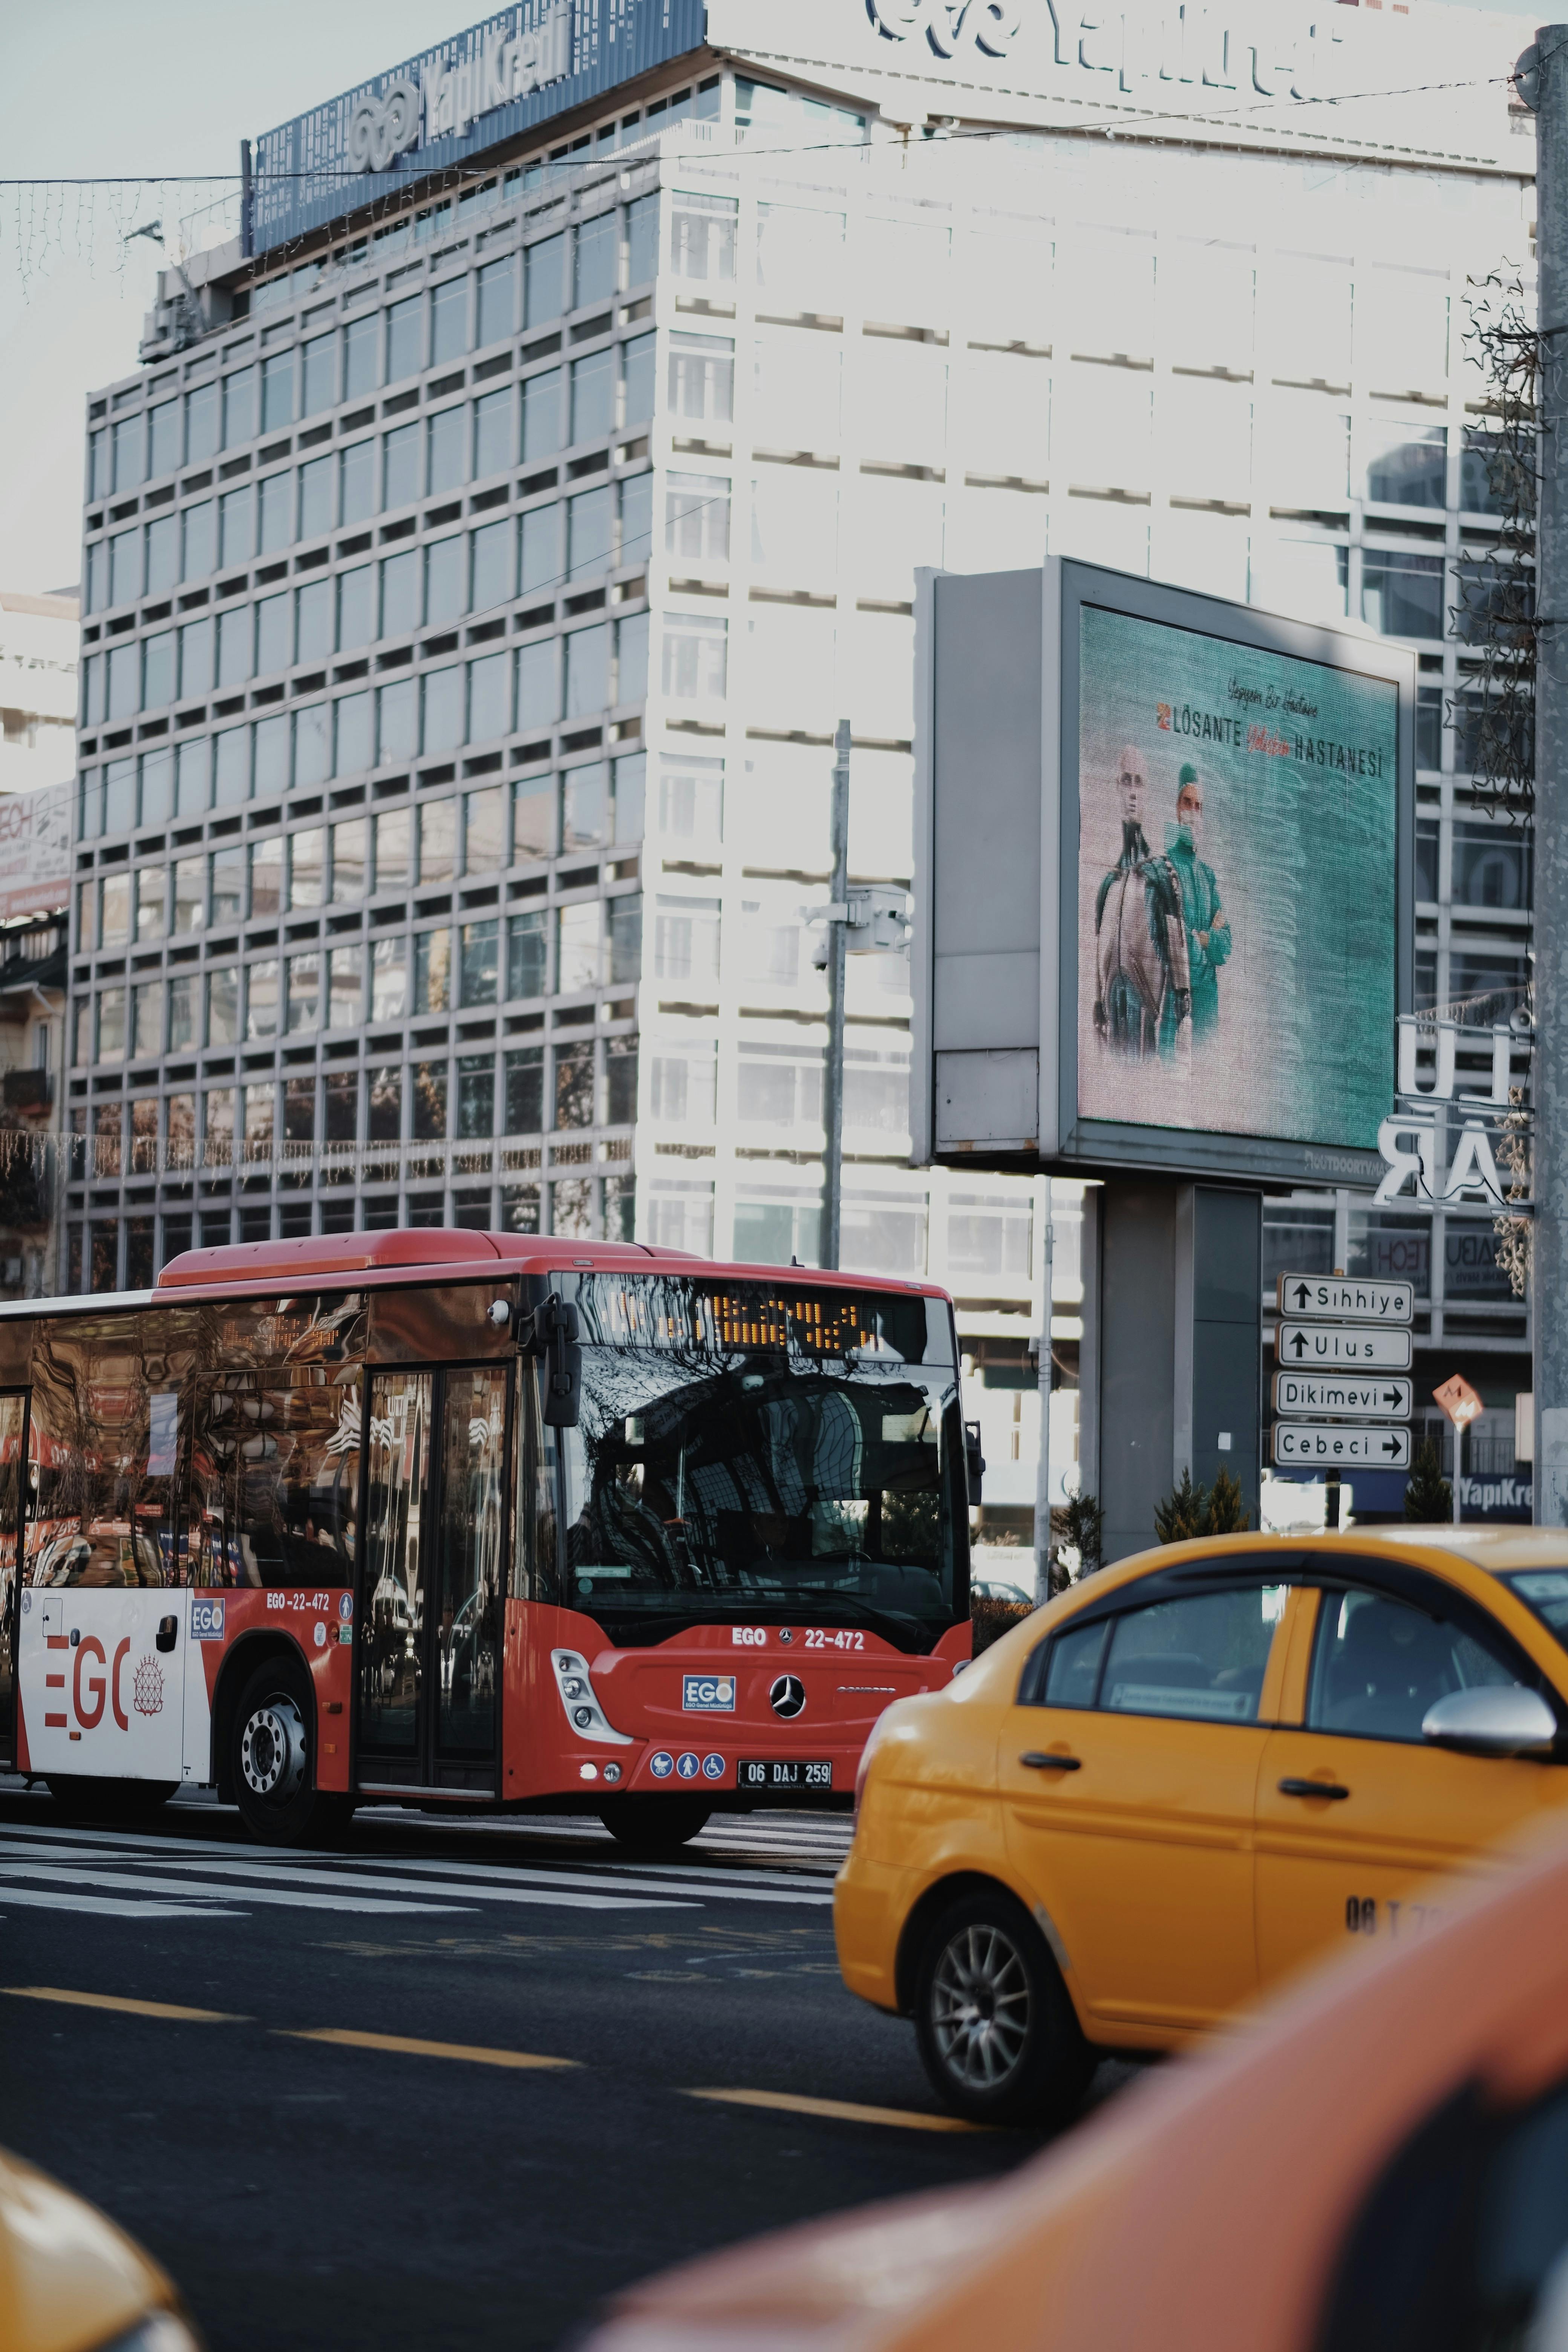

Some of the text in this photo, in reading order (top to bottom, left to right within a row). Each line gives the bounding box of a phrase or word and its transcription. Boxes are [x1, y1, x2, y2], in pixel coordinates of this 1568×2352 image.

[1173, 704, 1241, 747] LÖSANTE
[1295, 733, 1382, 778] HASTANESİ
[1317, 1286, 1404, 1315] Sıhhiye
[1315, 1336, 1374, 1357] Ulus
[1286, 1383, 1377, 1406] Dikimevi
[1283, 1435, 1368, 1455] Cebeci
[193, 1607, 222, 1630] EGO
[732, 1627, 864, 1650] EGO 22-472
[686, 1682, 732, 1702] EGO
[748, 1764, 828, 1782] 06 DAJ 259
